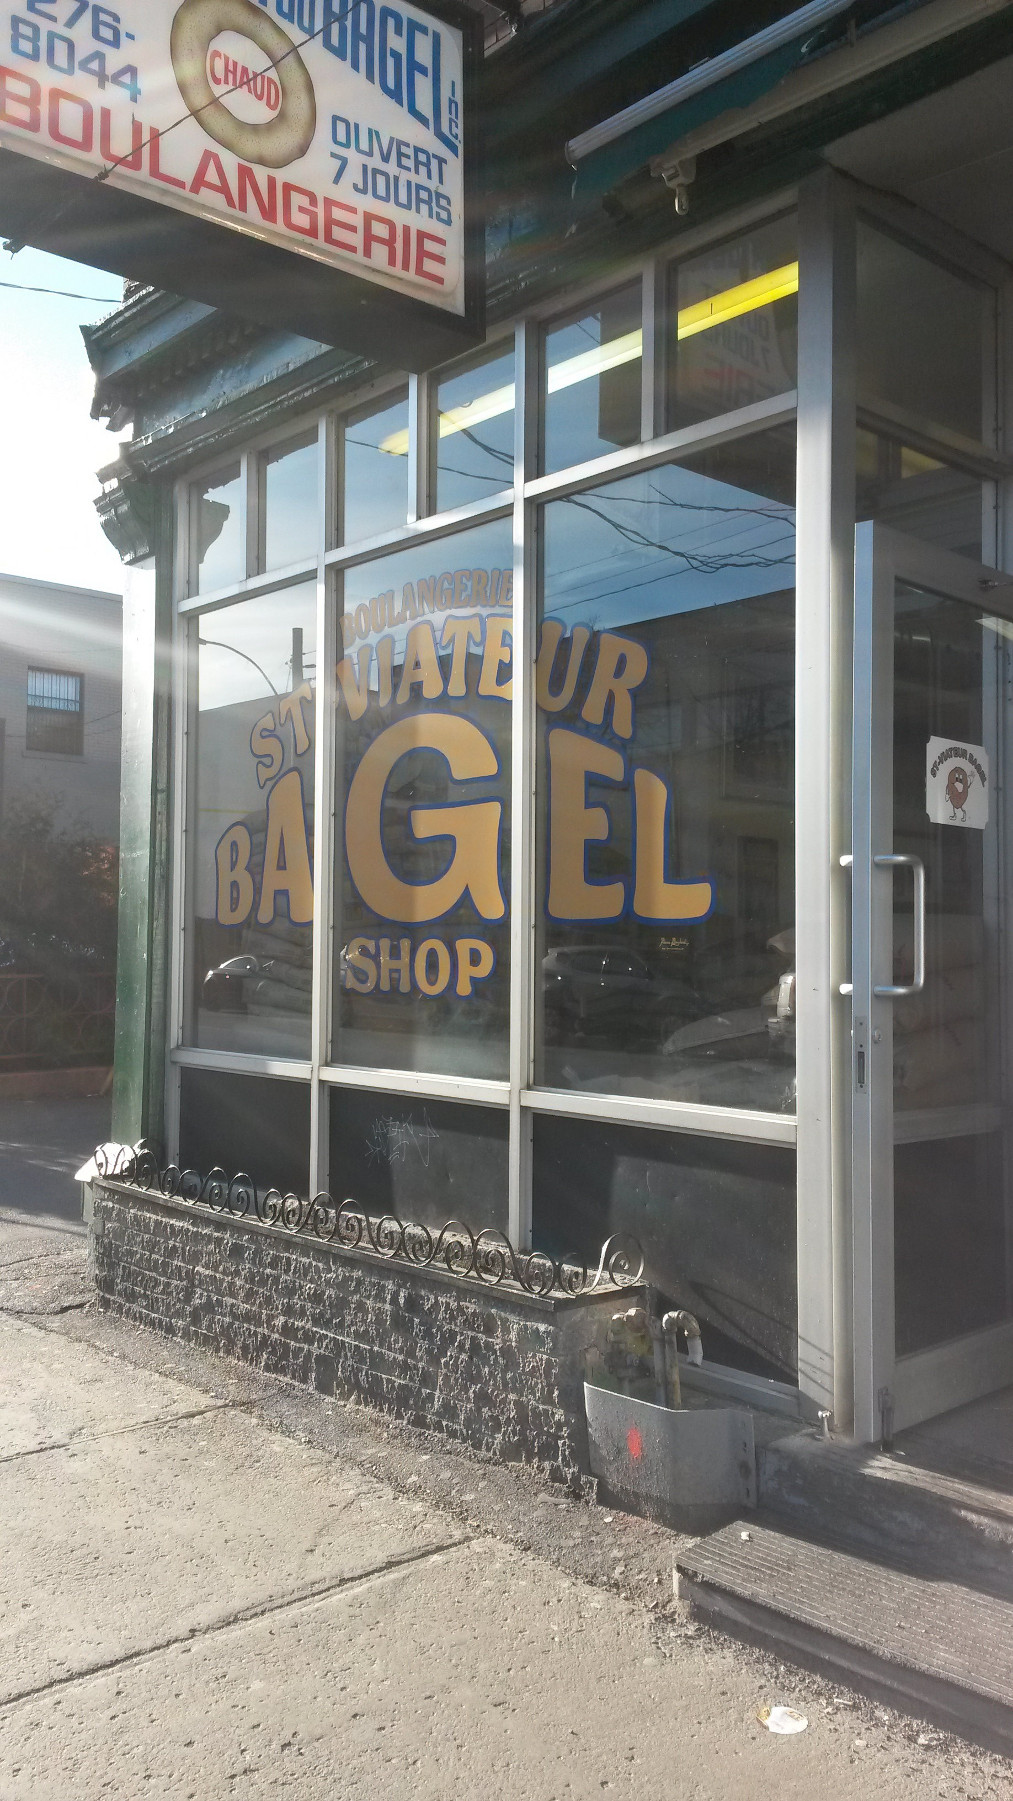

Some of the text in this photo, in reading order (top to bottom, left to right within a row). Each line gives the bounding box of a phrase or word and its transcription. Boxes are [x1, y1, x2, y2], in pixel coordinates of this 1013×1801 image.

[10, 14, 142, 104] 8044
[209, 48, 281, 111] CHAUD
[322, 0, 459, 158] BAGEL
[0, 65, 447, 286] BOULANGERIE
[329, 151, 453, 227] 7 JOURS
[330, 114, 447, 186] OUVERT
[338, 567, 513, 650] BOULANGERIE
[250, 612, 652, 789] ST VIATEUR
[215, 708, 714, 928] BAGEL
[344, 933, 497, 1000] SHOP
